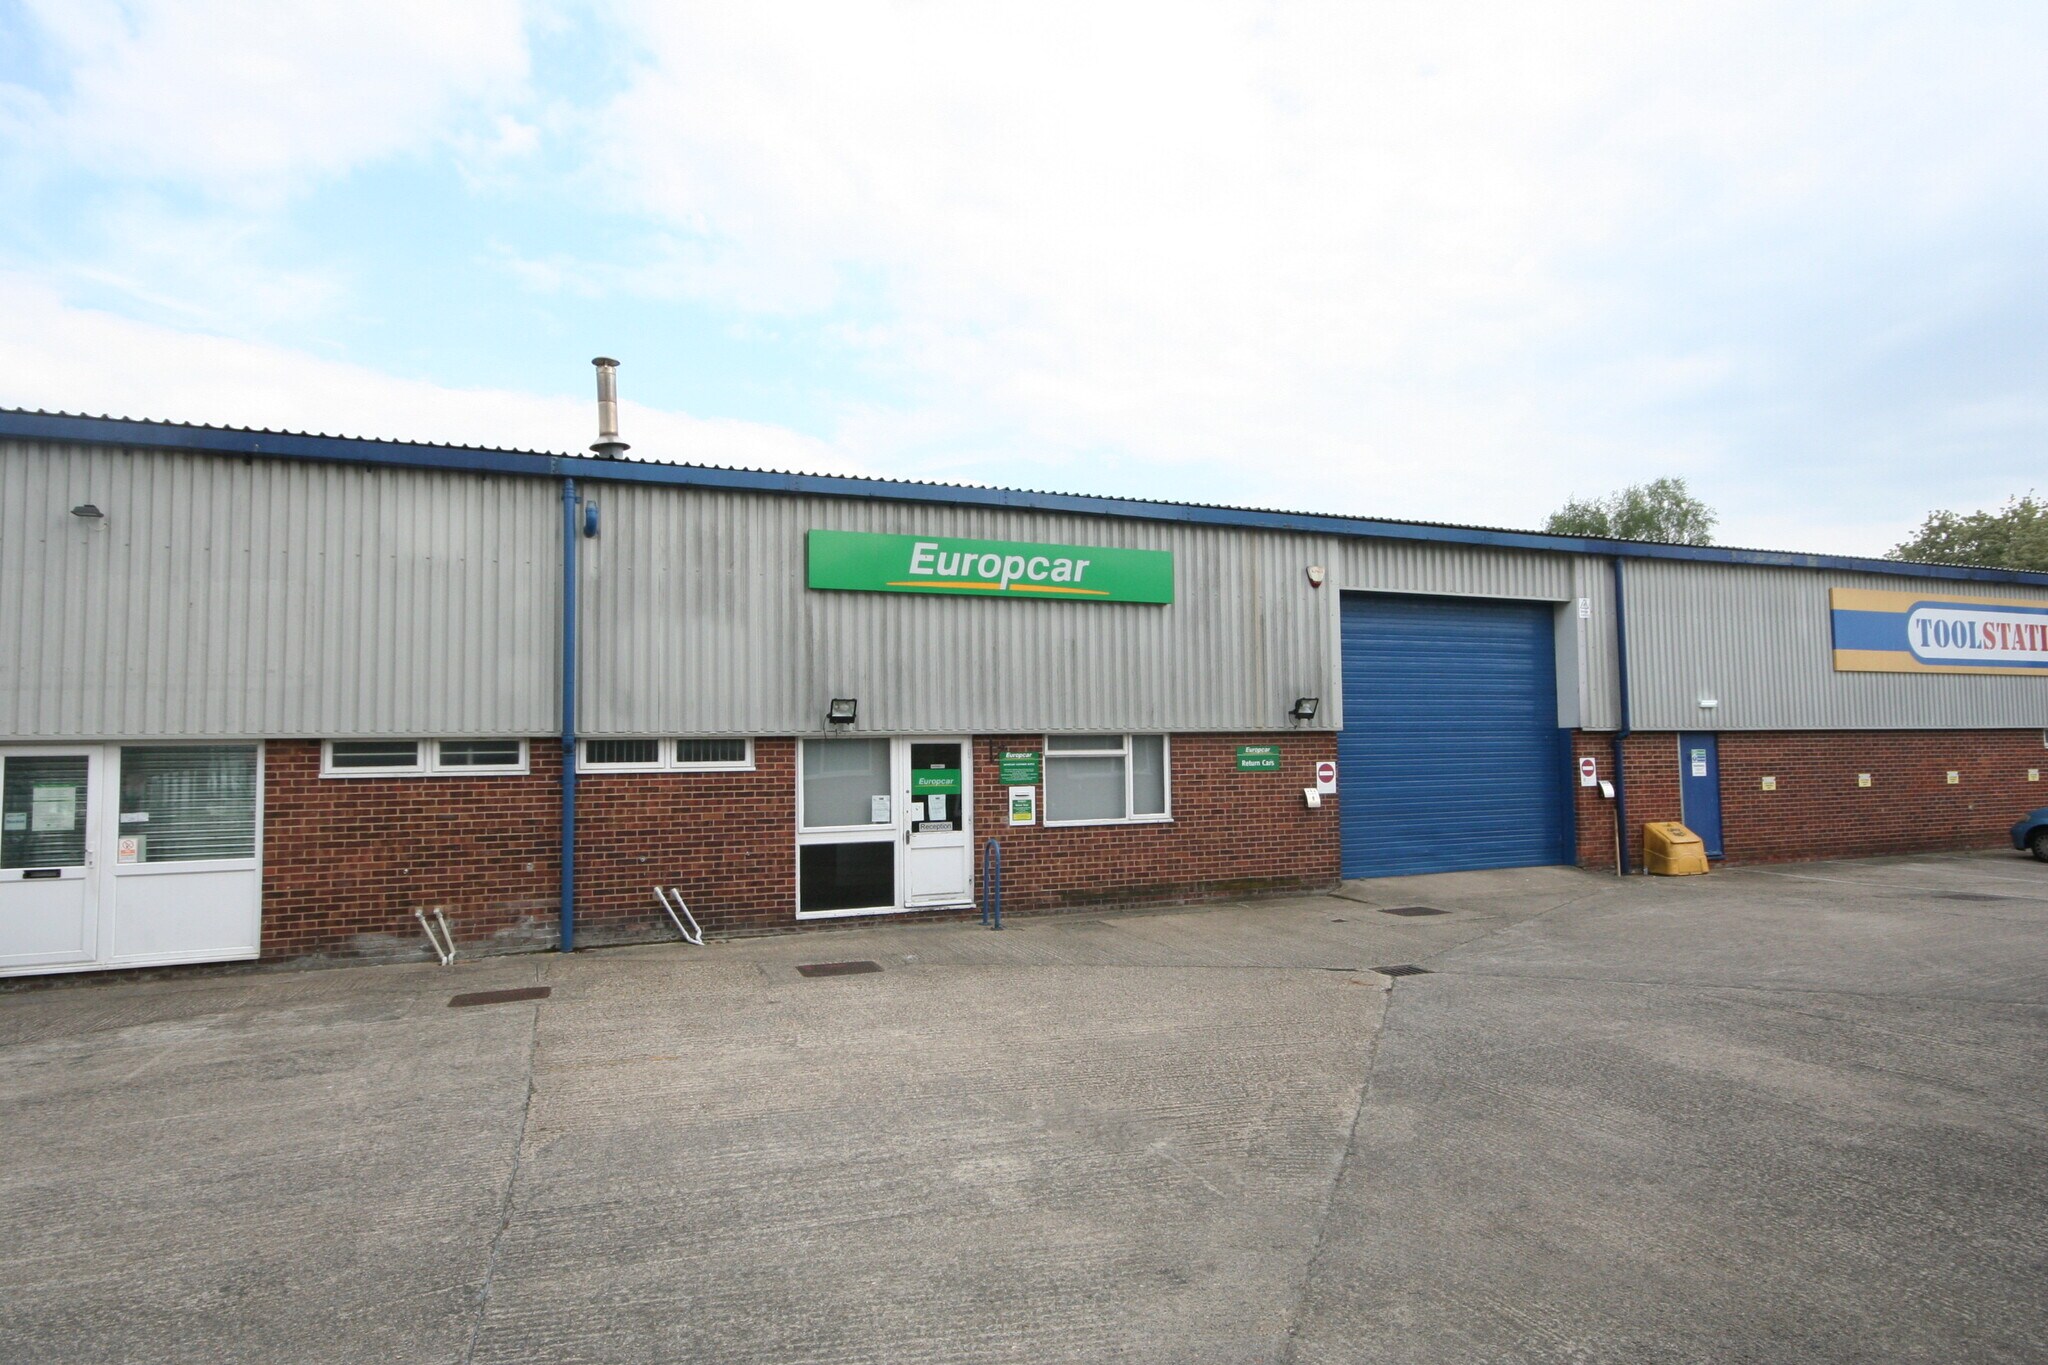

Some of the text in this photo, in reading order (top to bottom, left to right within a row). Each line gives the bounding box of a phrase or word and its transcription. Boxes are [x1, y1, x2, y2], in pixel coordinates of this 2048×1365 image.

[908, 541, 1090, 590] Europcar
[1245, 746, 1271, 754] Europcar
[1241, 759, 1260, 767] Return
[918, 777, 954, 786] Europcar
[920, 823, 952, 831] Reception
